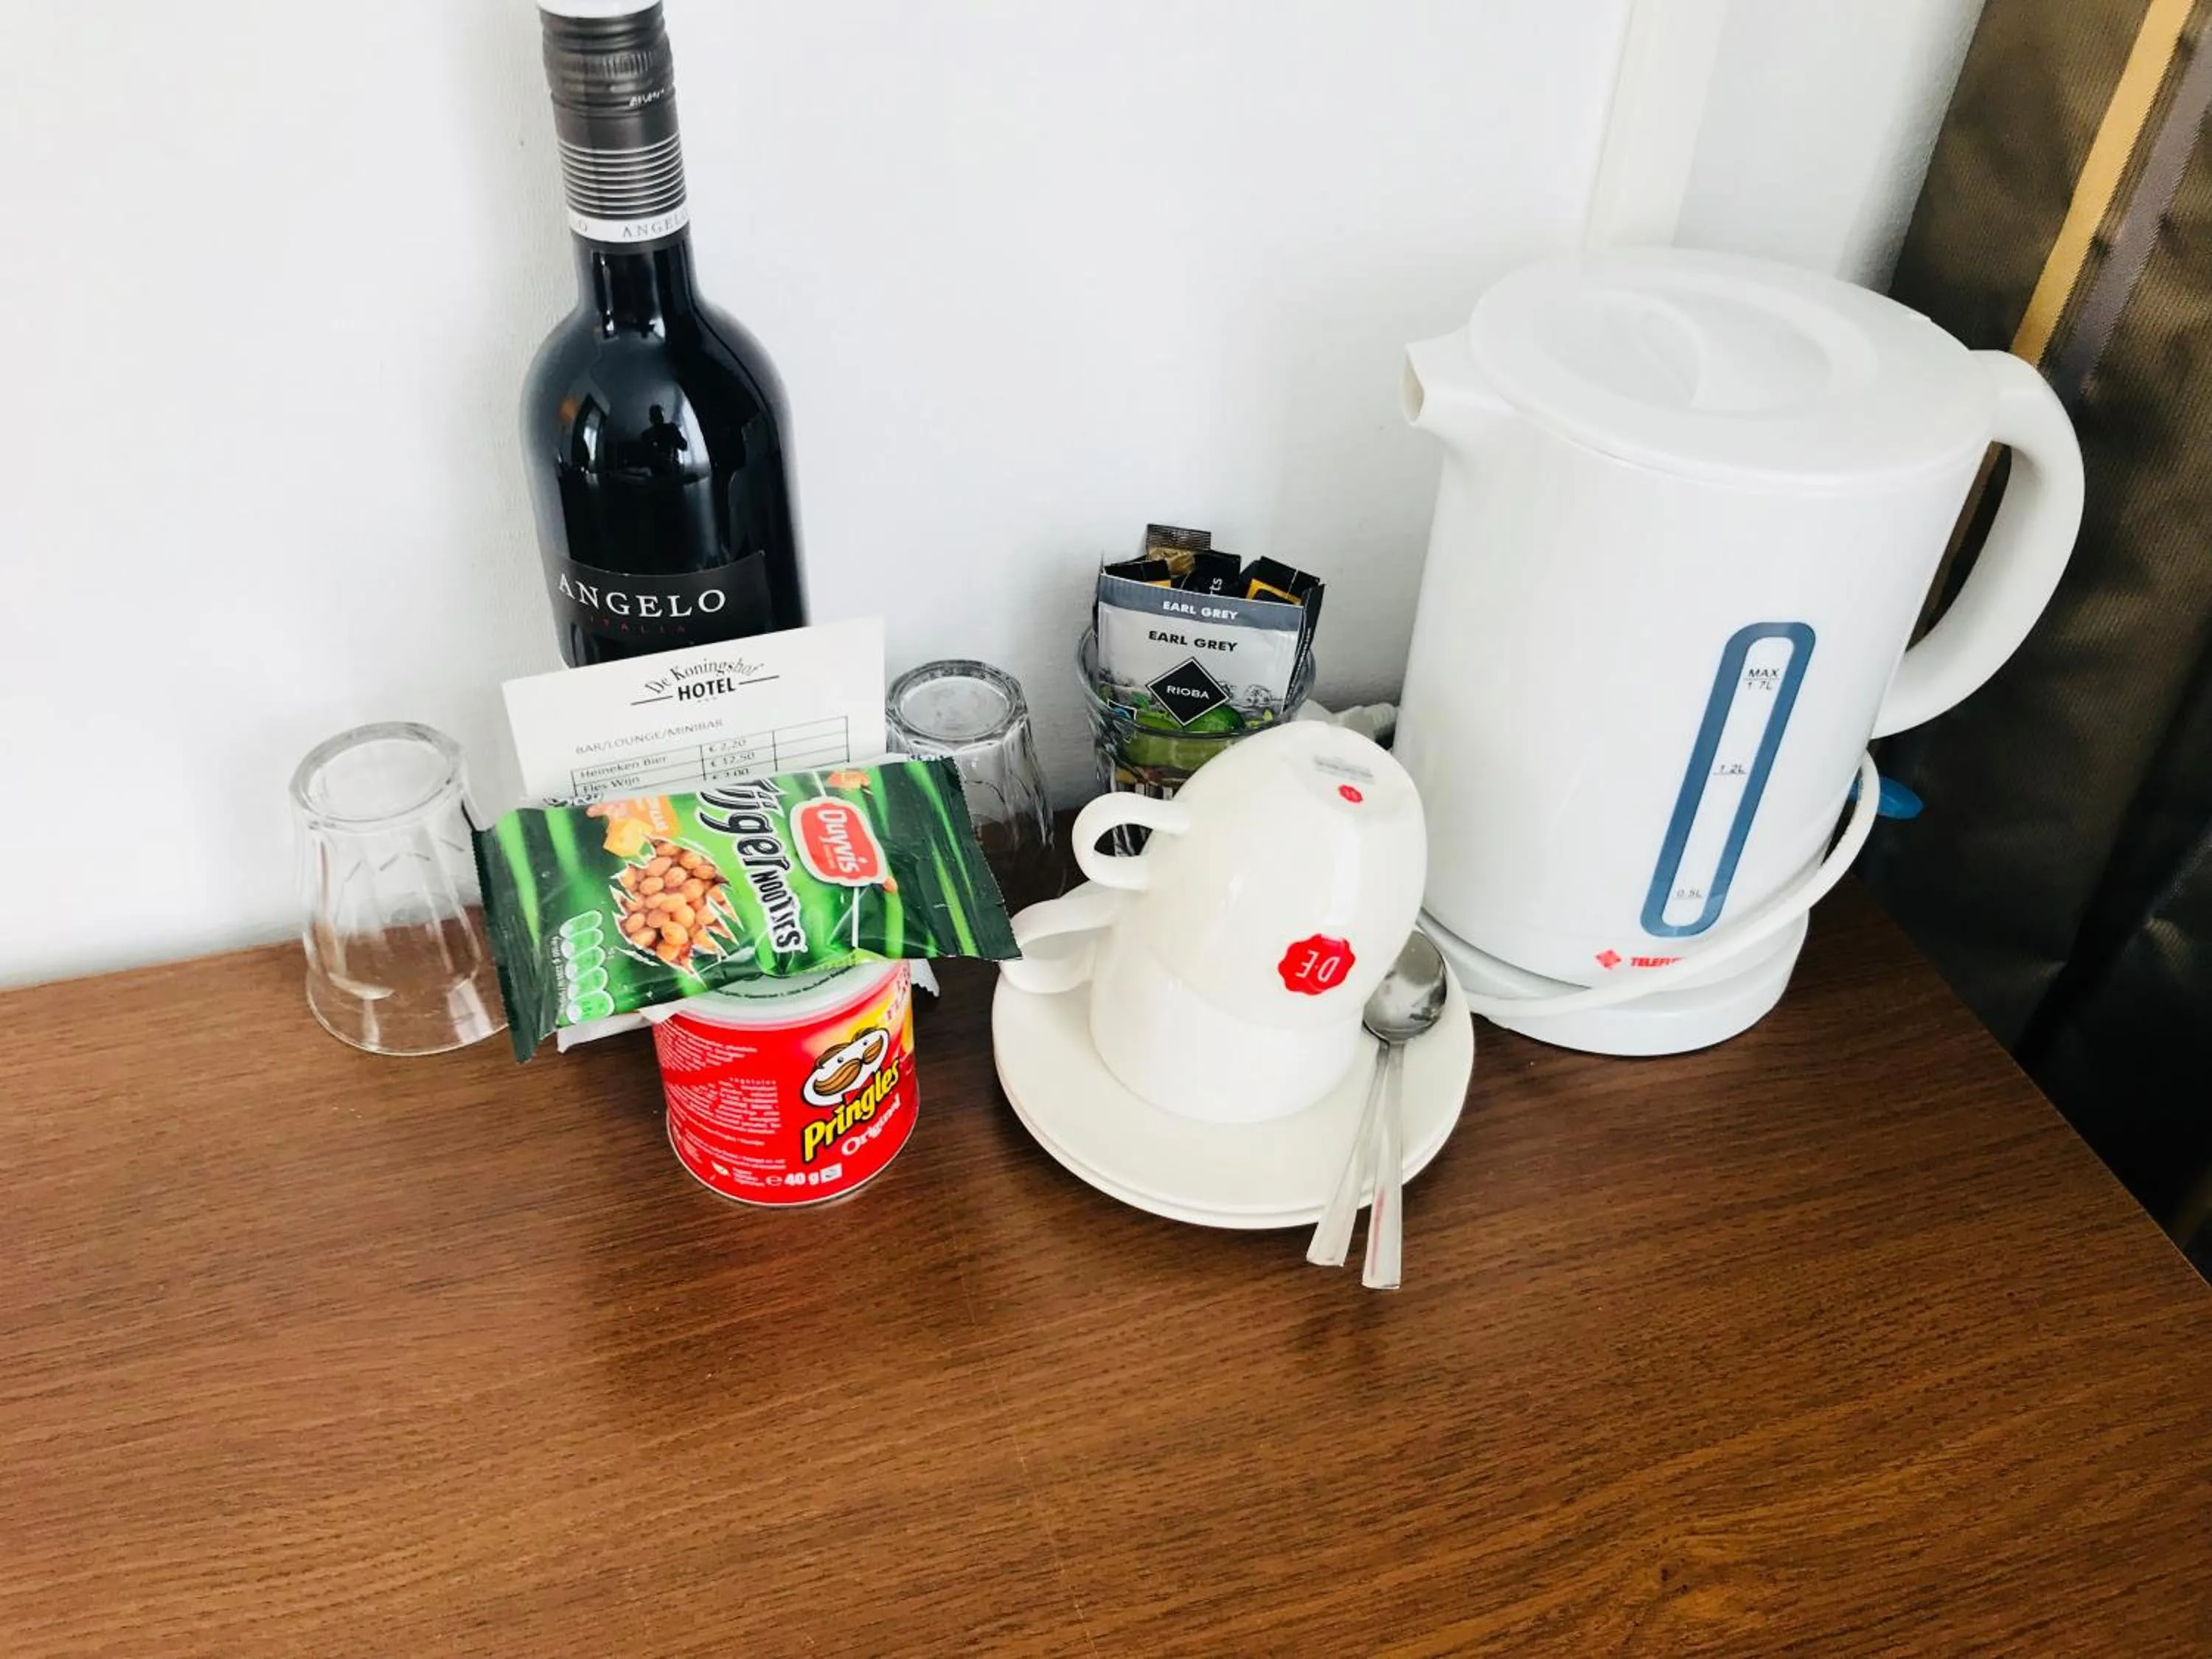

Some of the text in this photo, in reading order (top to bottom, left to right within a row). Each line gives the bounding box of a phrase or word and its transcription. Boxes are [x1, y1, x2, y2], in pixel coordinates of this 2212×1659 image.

[558, 572, 727, 618] ANGELO
[1163, 601, 1239, 620] EARL GREY
[1148, 630, 1239, 652] EARL GREY
[1747, 668, 1779, 678] MAX
[644, 677, 672, 694] De
[678, 677, 737, 701] HOTEL
[1166, 684, 1211, 700] RIOBA
[580, 759, 640, 779] Heineken
[817, 809, 869, 874] Duyvis
[803, 1058, 900, 1163] Pringles
[841, 1093, 901, 1156] Original
[784, 1172, 806, 1186] 40
[808, 1172, 820, 1185] g
